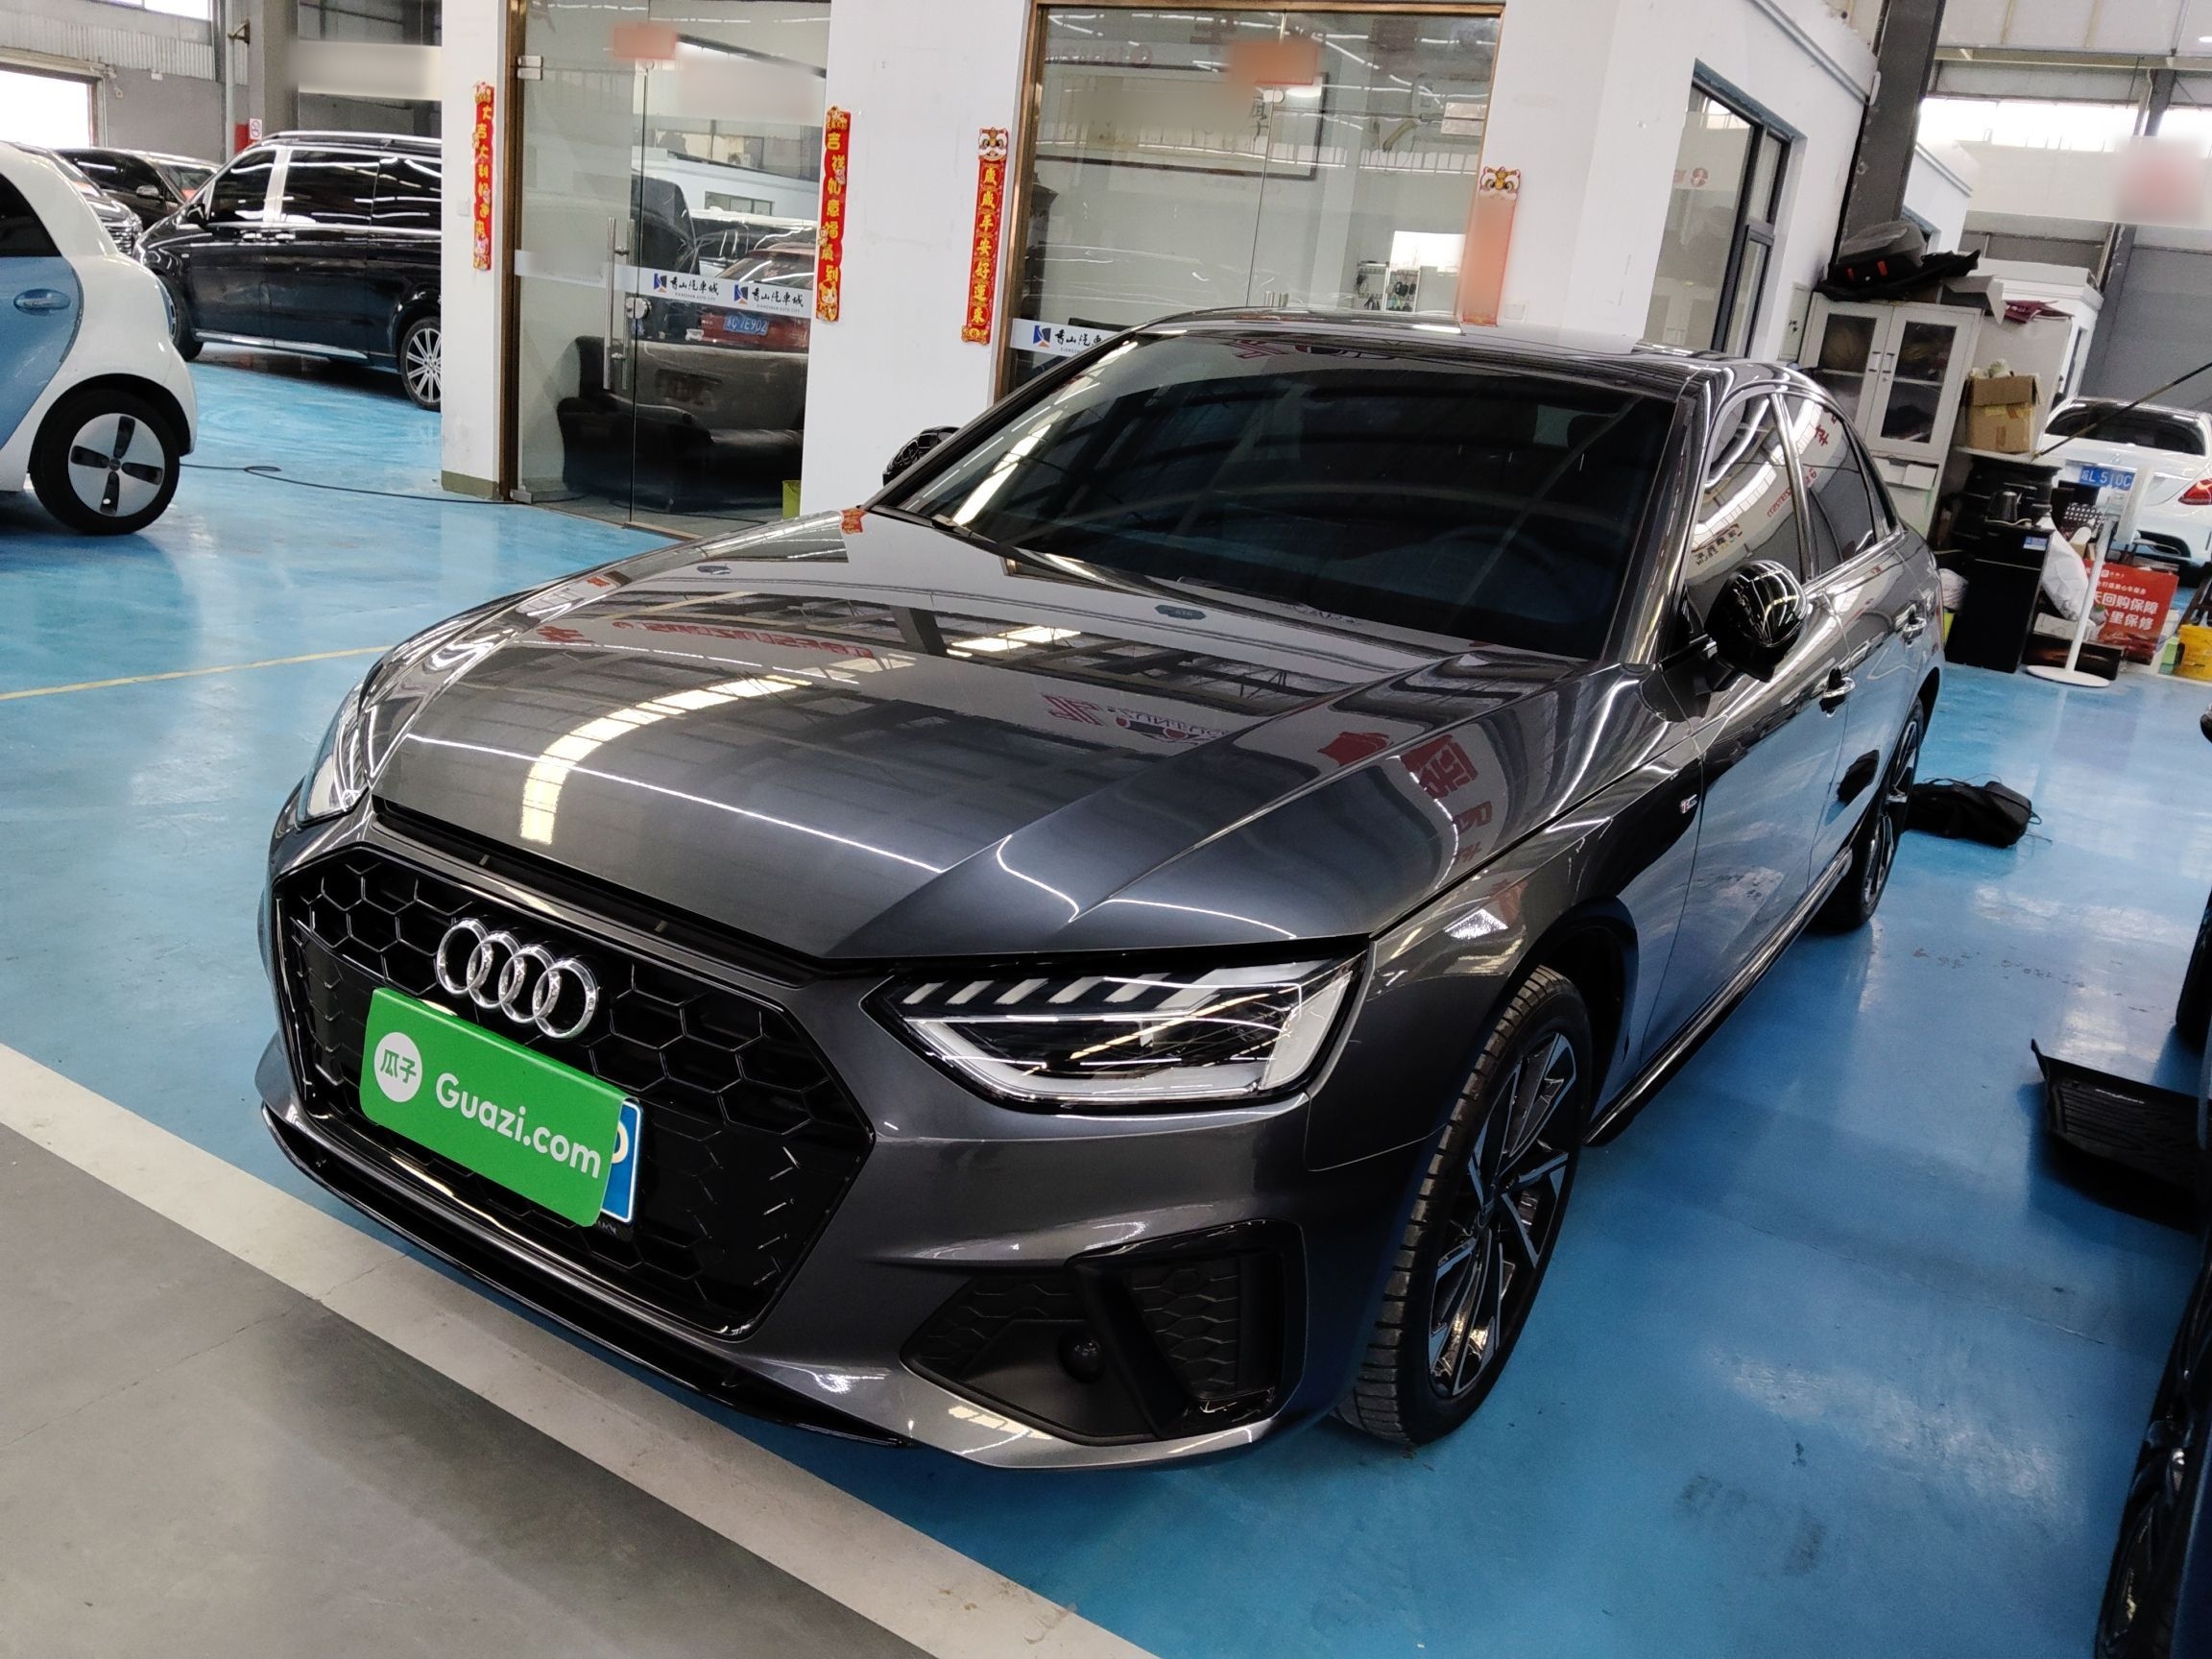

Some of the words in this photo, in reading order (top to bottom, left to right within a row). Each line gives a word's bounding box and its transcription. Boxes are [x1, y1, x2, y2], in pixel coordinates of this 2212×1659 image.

[2104, 609, 2154, 630] 里保修
[379, 1048, 417, 1084] 瓜子
[435, 1072, 602, 1179] Guazi.com
